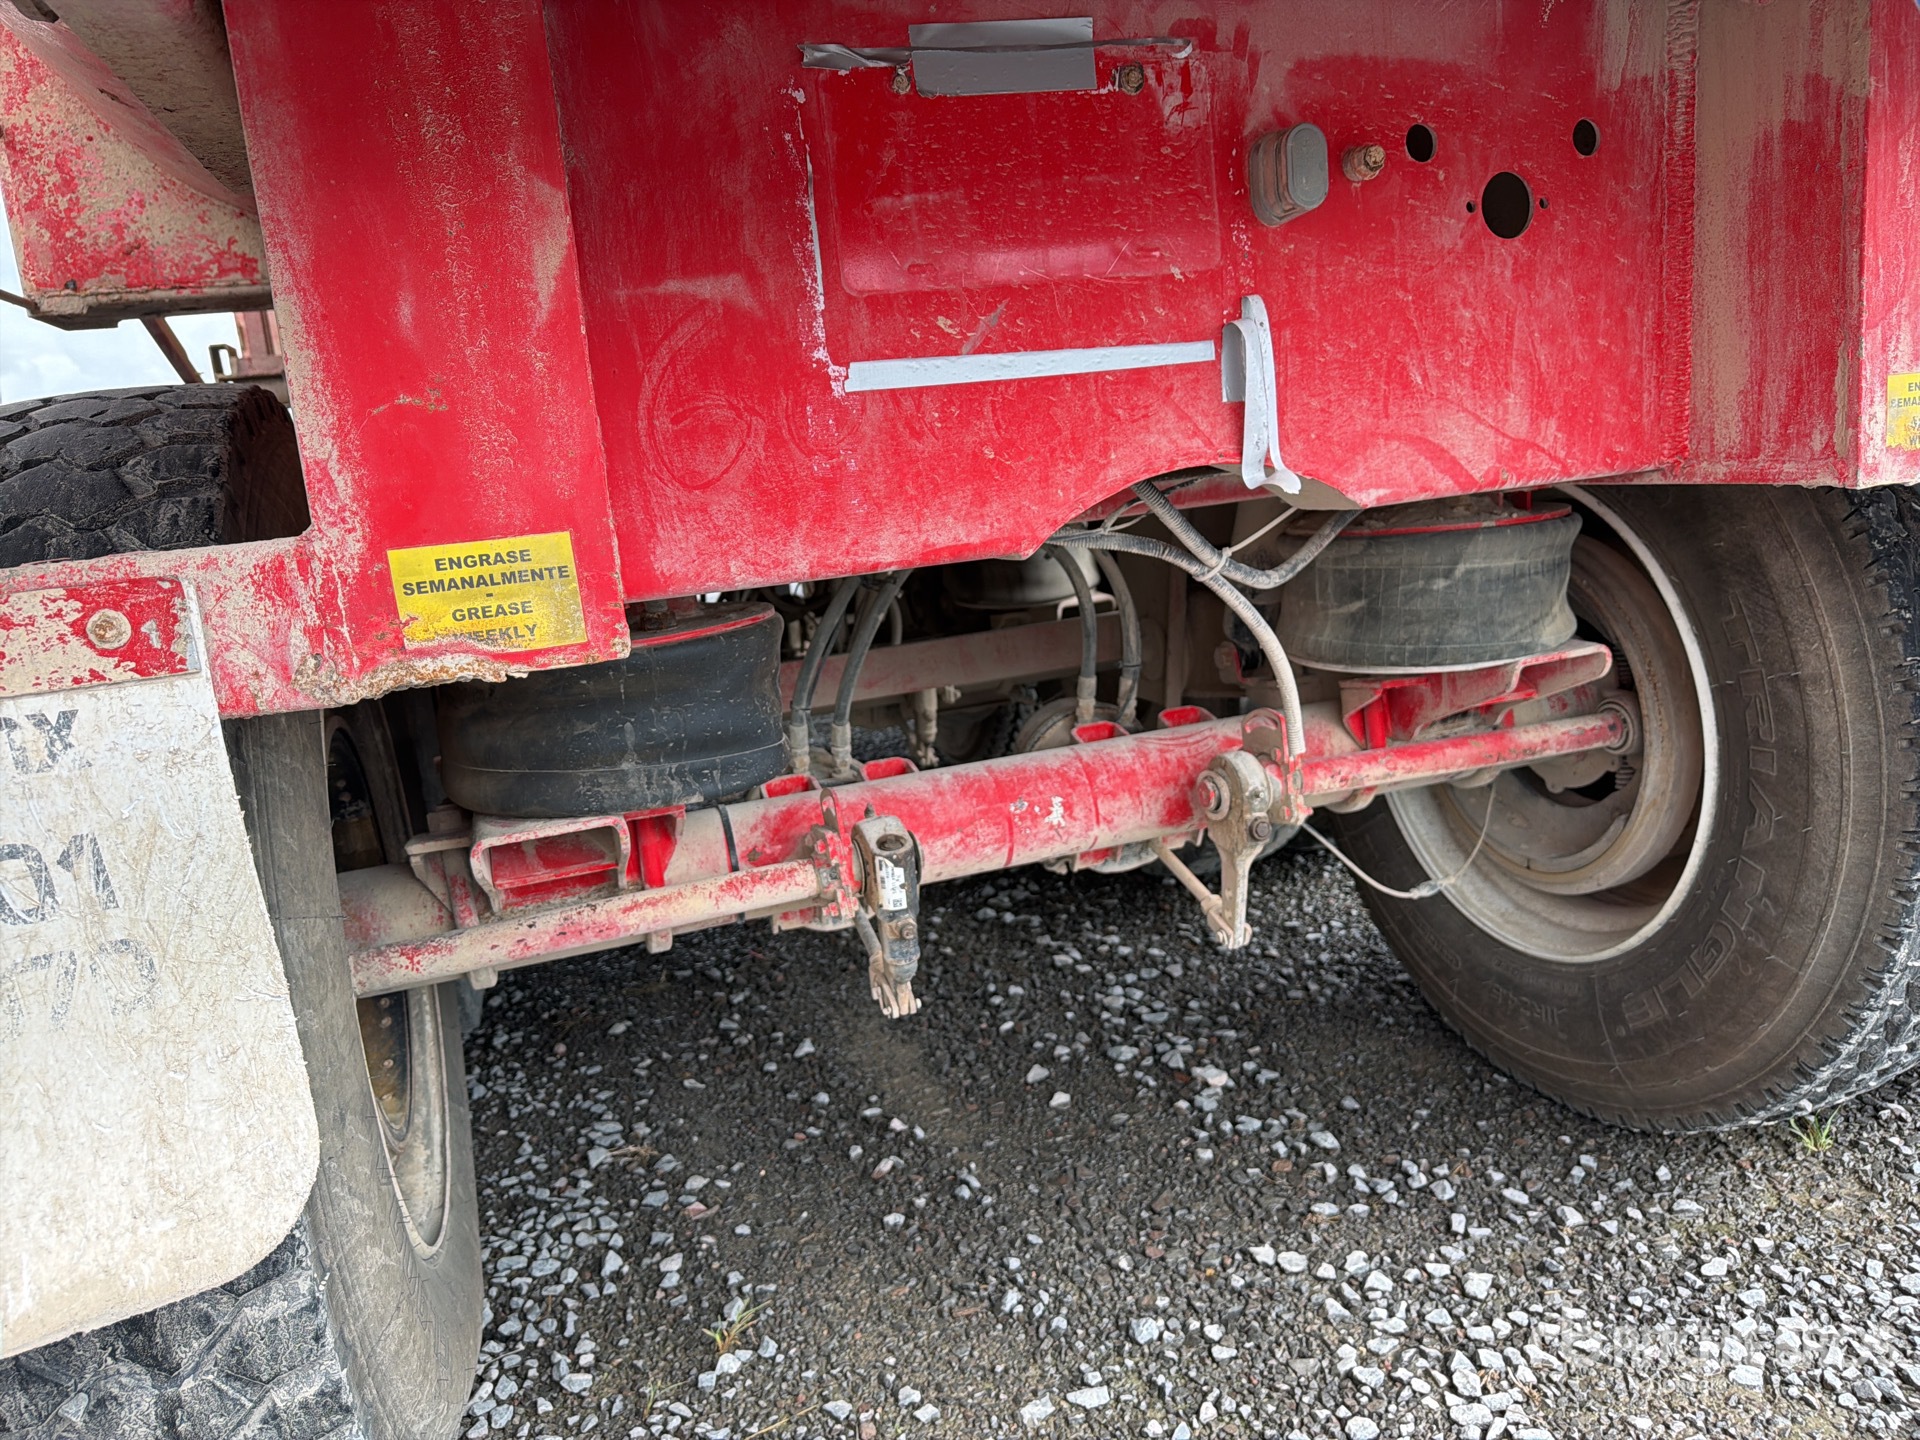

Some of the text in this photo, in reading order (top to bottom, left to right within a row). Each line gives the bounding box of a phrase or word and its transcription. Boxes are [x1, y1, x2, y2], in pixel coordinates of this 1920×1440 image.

[434, 549, 532, 572] ENGRASE
[402, 565, 570, 596] SEMANALMENTE
[452, 601, 533, 622] GREASE
